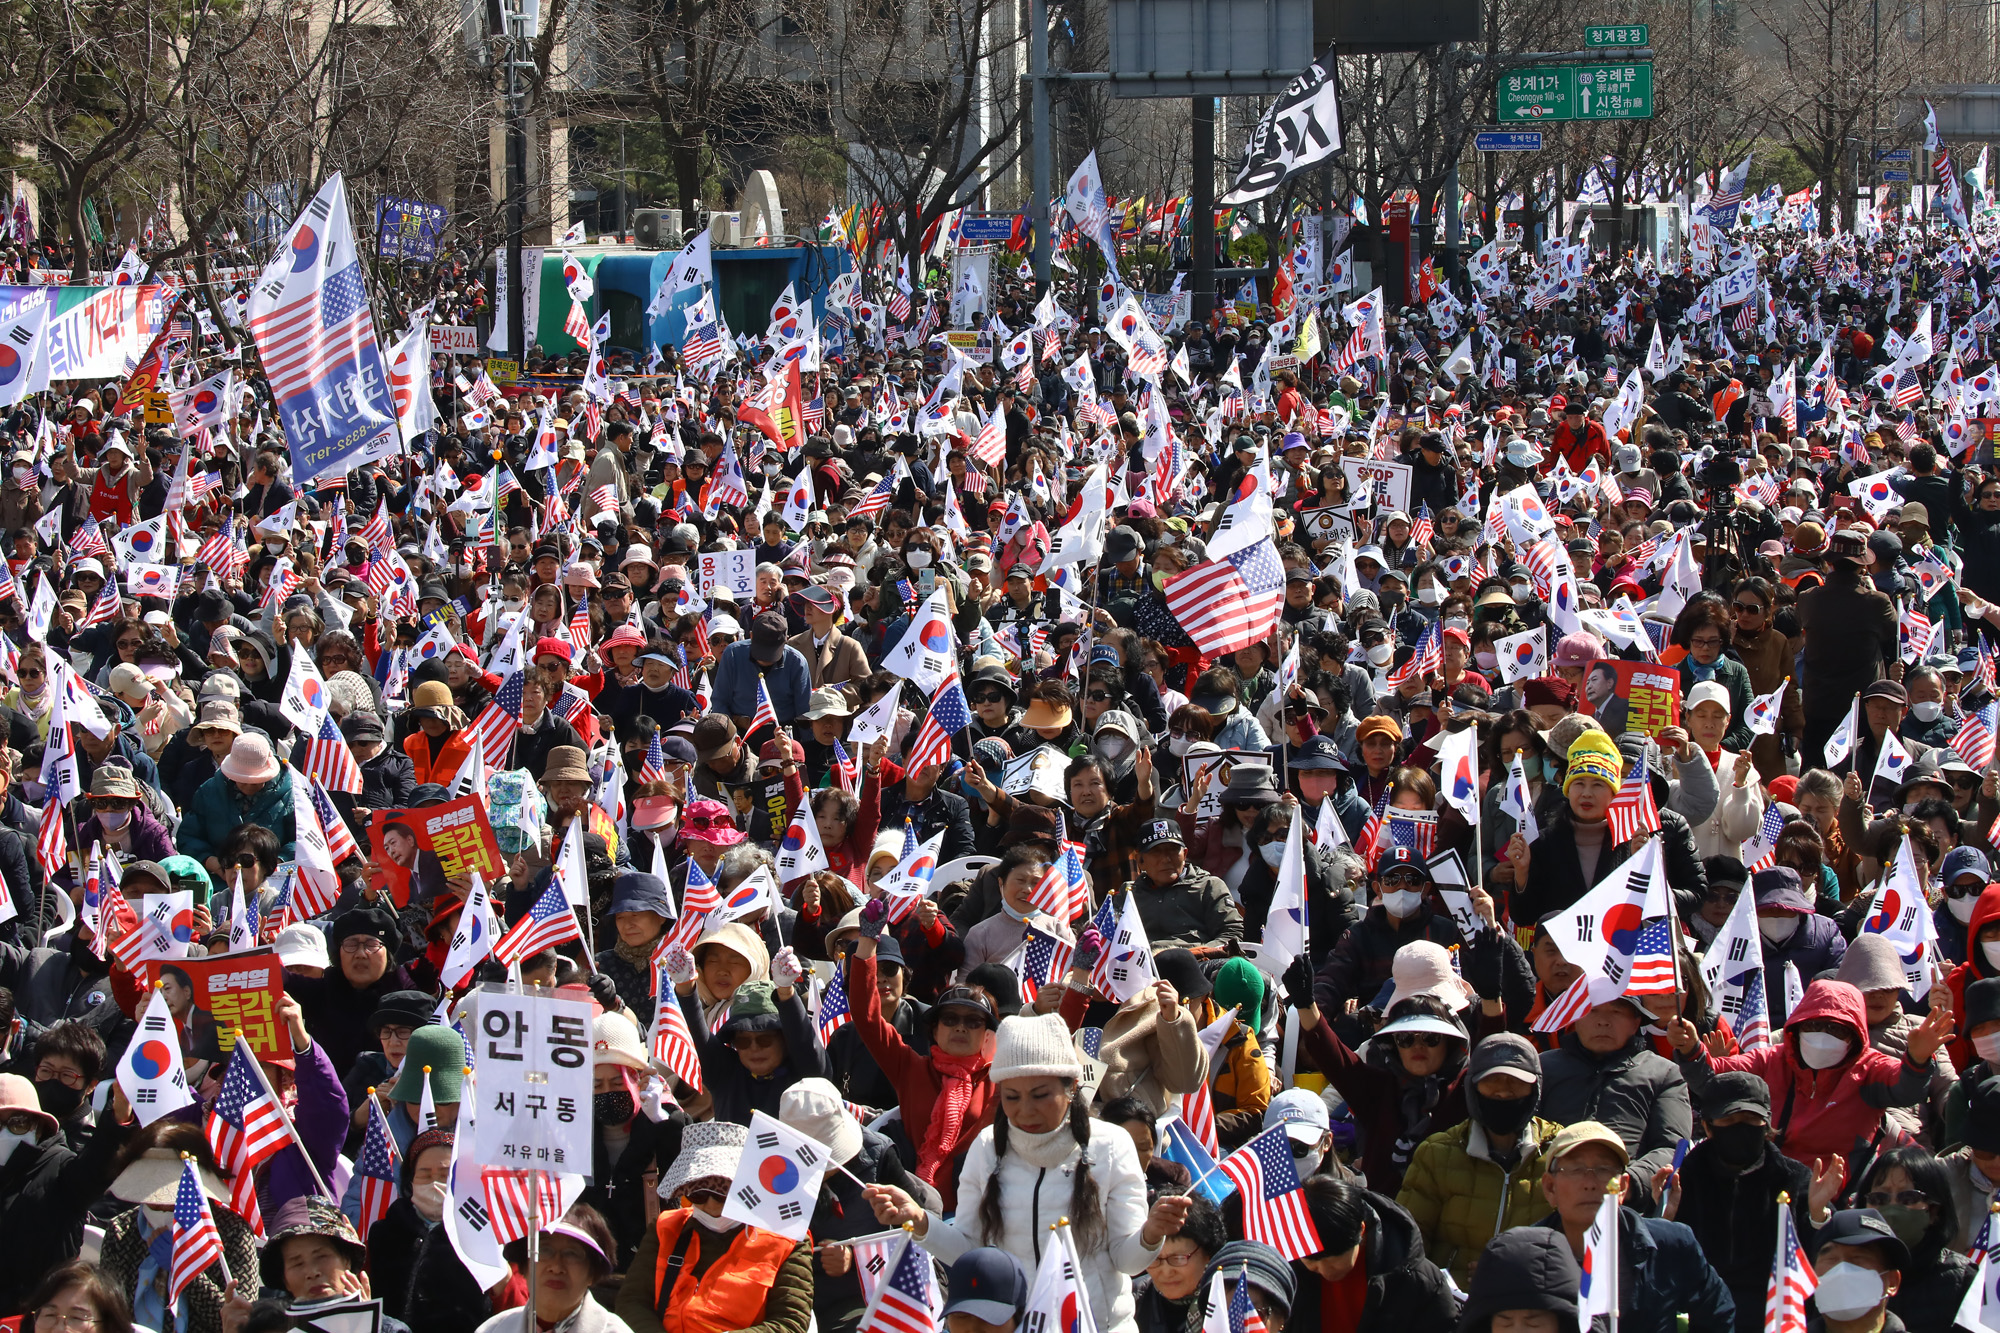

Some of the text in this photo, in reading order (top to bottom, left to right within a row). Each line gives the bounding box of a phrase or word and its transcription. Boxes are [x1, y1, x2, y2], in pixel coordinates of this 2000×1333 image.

[1591, 28, 1641, 43] 청계광장
[1508, 75, 1560, 92] 청계1가
[1580, 75, 1592, 83] 60
[1595, 68, 1637, 82] 숭례문
[1507, 92, 1544, 104] Cheonggye
[1596, 83, 1631, 94] 崇禮門
[1595, 95, 1622, 109] 시청
[1595, 109, 1612, 118] City
[1509, 135, 1539, 143] 청계천로
[143, 298, 164, 325] 자유
[84, 286, 126, 359] 기각!
[430, 328, 477, 350] 부산 21A
[490, 359, 517, 372] 경북의성
[1269, 356, 1298, 369] 탄핵무효
[1357, 466, 1394, 483] STOP
[1371, 480, 1389, 495] HE
[1630, 671, 1674, 691] 윤석열
[1628, 687, 1674, 716] 즉각
[1626, 711, 1673, 738] 복귀
[426, 805, 476, 835] 윤석열
[430, 823, 485, 859] 즉각
[440, 847, 494, 881] 복귀
[208, 968, 270, 993] 윤석열
[210, 990, 274, 1026] 즉각
[216, 1021, 278, 1053] 복귀
[482, 1009, 589, 1069] 안동
[494, 1091, 577, 1123] 서구동
[1276, 1110, 1304, 1120] emis
[502, 1143, 566, 1164] 자유마을
